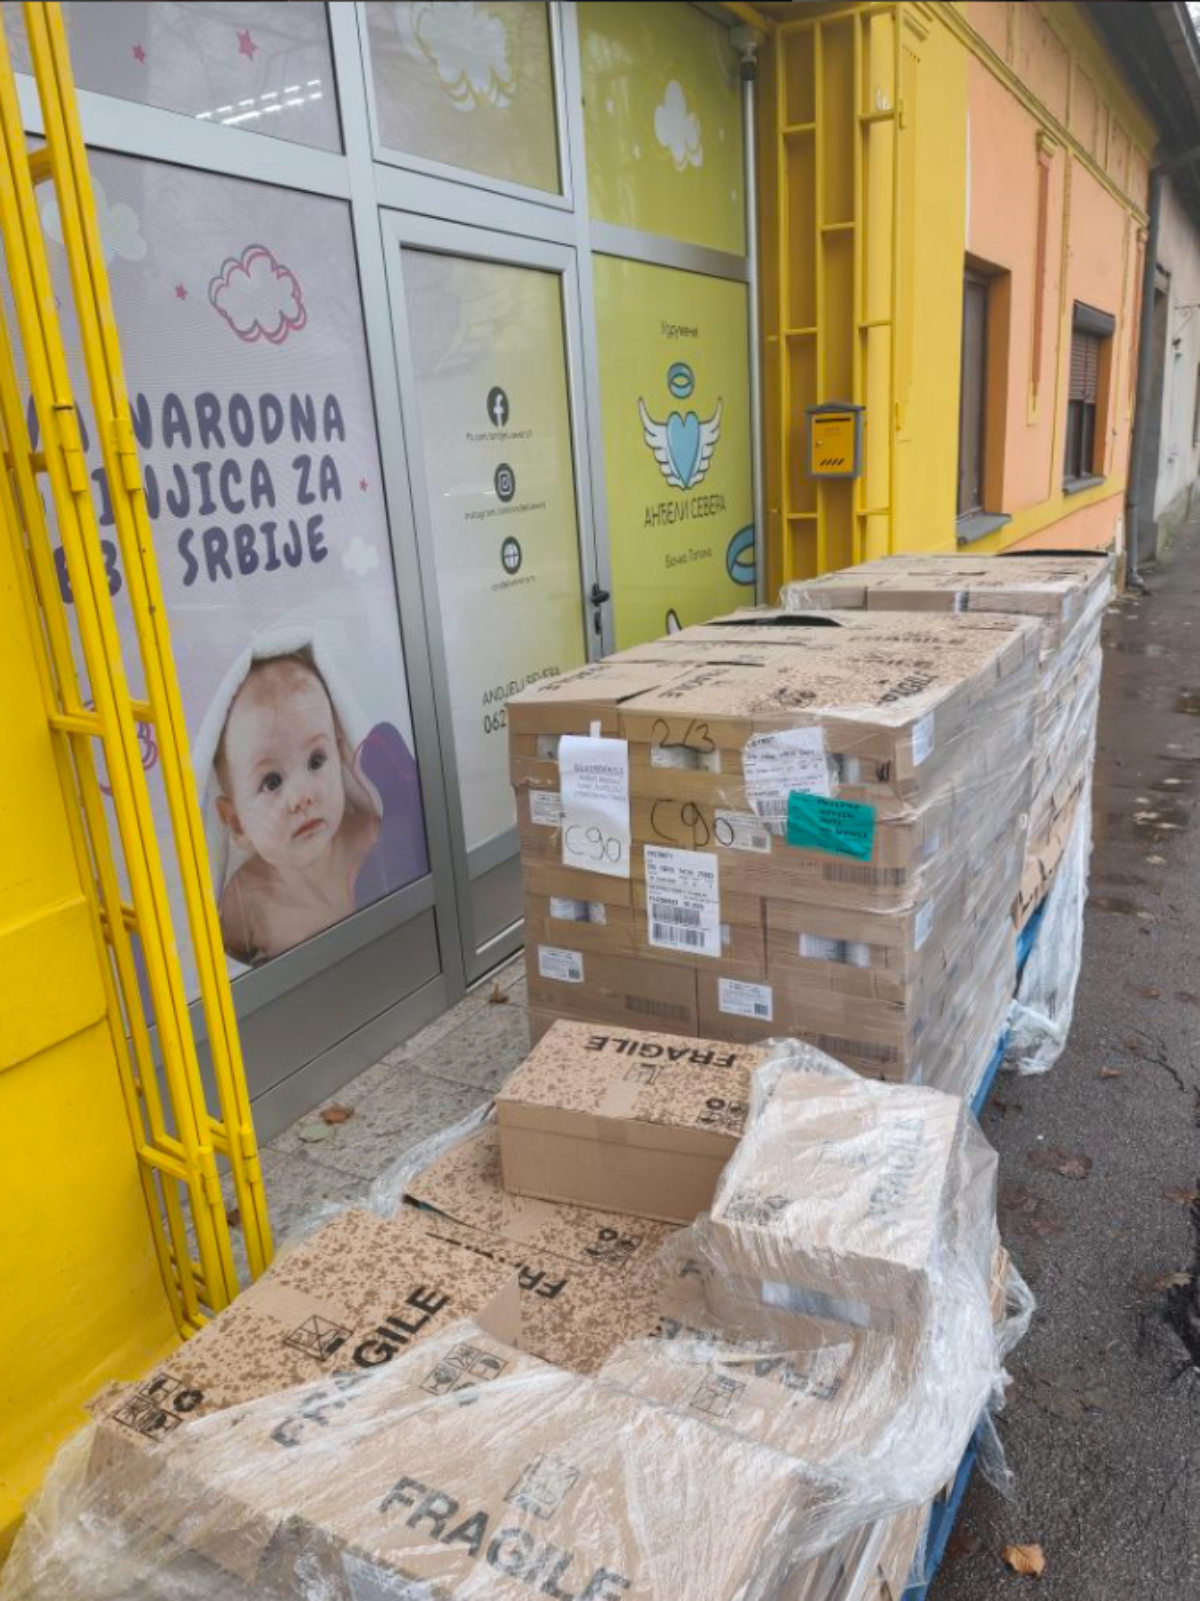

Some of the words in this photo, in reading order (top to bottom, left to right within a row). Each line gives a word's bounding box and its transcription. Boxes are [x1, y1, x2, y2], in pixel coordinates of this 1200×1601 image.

[129, 392, 346, 450] NARODNA
[291, 454, 342, 505] ZA
[177, 513, 328, 587] SRBIJE
[652, 717, 716, 754] 2/3
[564, 824, 622, 863] C90
[650, 798, 735, 847] C90
[584, 1035, 737, 1069] FRAGILE
